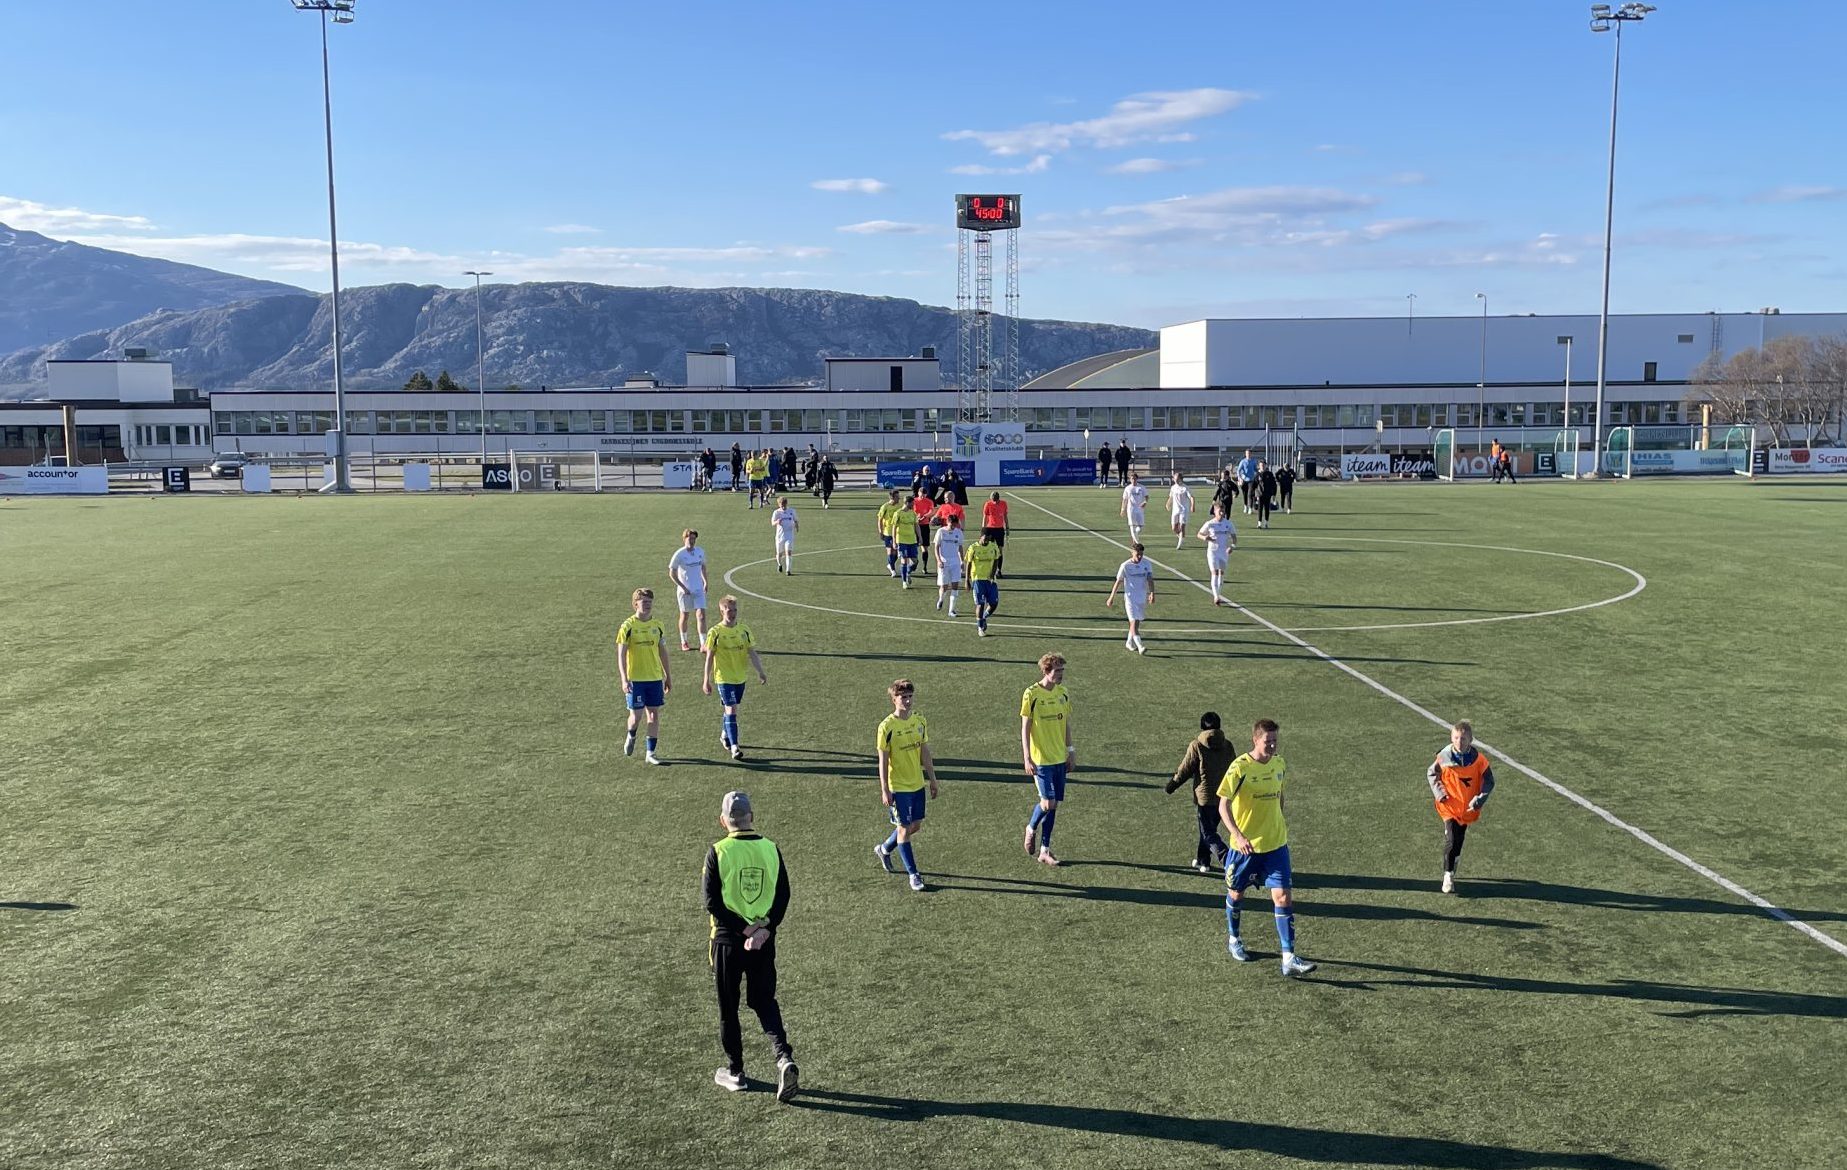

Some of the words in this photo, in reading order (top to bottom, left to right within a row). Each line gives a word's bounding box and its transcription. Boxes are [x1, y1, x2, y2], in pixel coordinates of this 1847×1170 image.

[974, 198, 980, 208] 0
[998, 198, 1004, 208] 0
[976, 209, 1003, 218] 45:00
[1346, 456, 1388, 472] iteam
[1394, 456, 1435, 473] iteam
[1454, 456, 1518, 474] MOI
[27, 470, 78, 478] accountor
